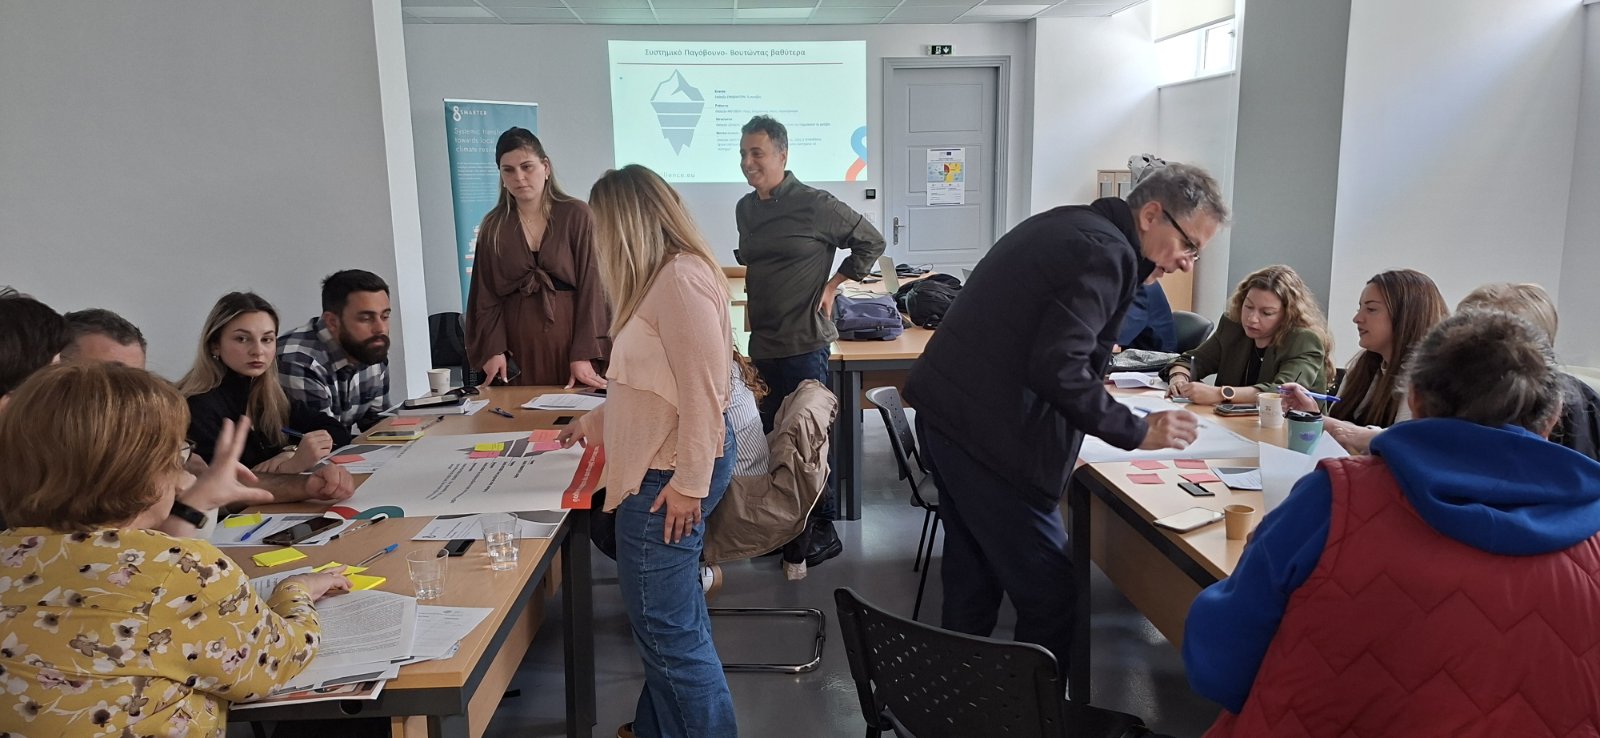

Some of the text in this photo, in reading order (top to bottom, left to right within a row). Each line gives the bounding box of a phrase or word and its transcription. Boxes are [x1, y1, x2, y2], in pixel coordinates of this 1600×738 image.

[645, 49, 682, 57] Συστημικό
[770, 48, 806, 57] βαθύτερα
[456, 145, 477, 153] climate
